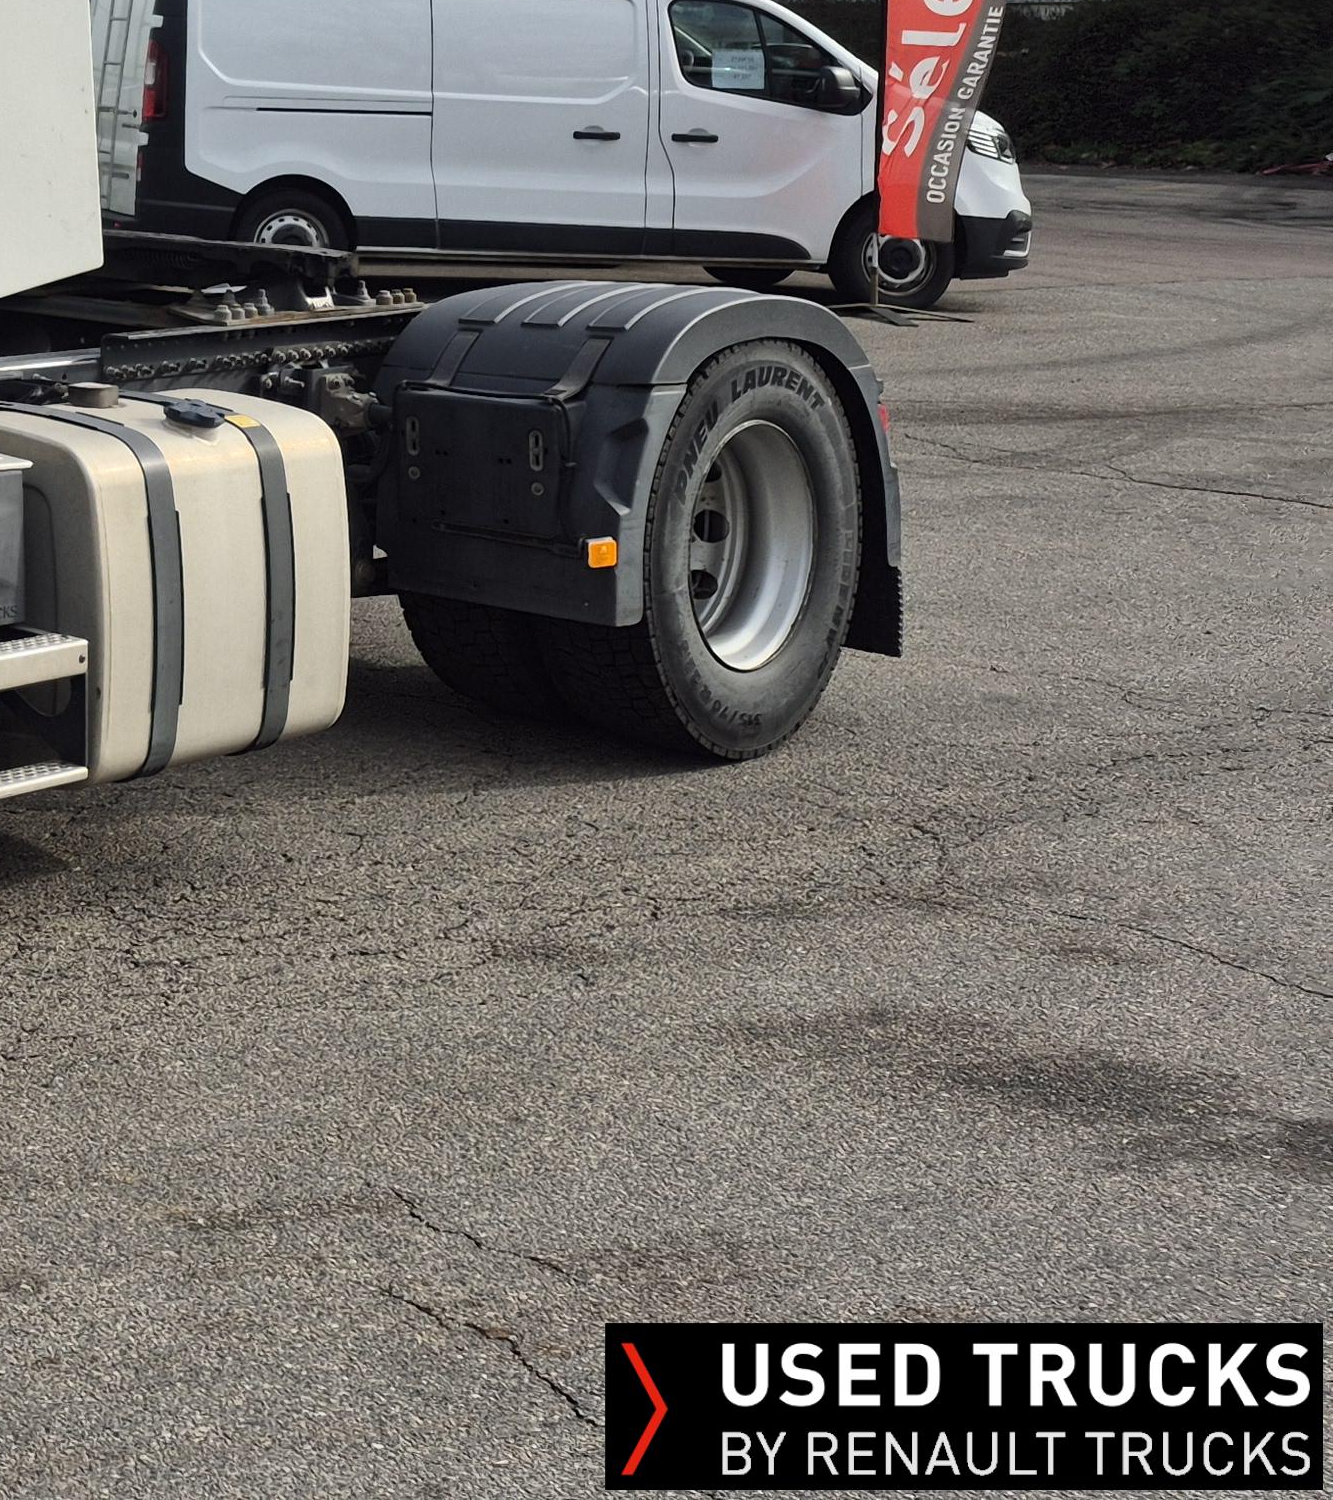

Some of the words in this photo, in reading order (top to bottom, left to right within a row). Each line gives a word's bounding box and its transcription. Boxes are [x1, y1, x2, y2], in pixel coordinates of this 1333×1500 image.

[926, 107, 966, 204] OCCASION
[957, 5, 1004, 101] GARANTIE
[674, 401, 719, 503] PNEU
[731, 366, 825, 411] LAURENT
